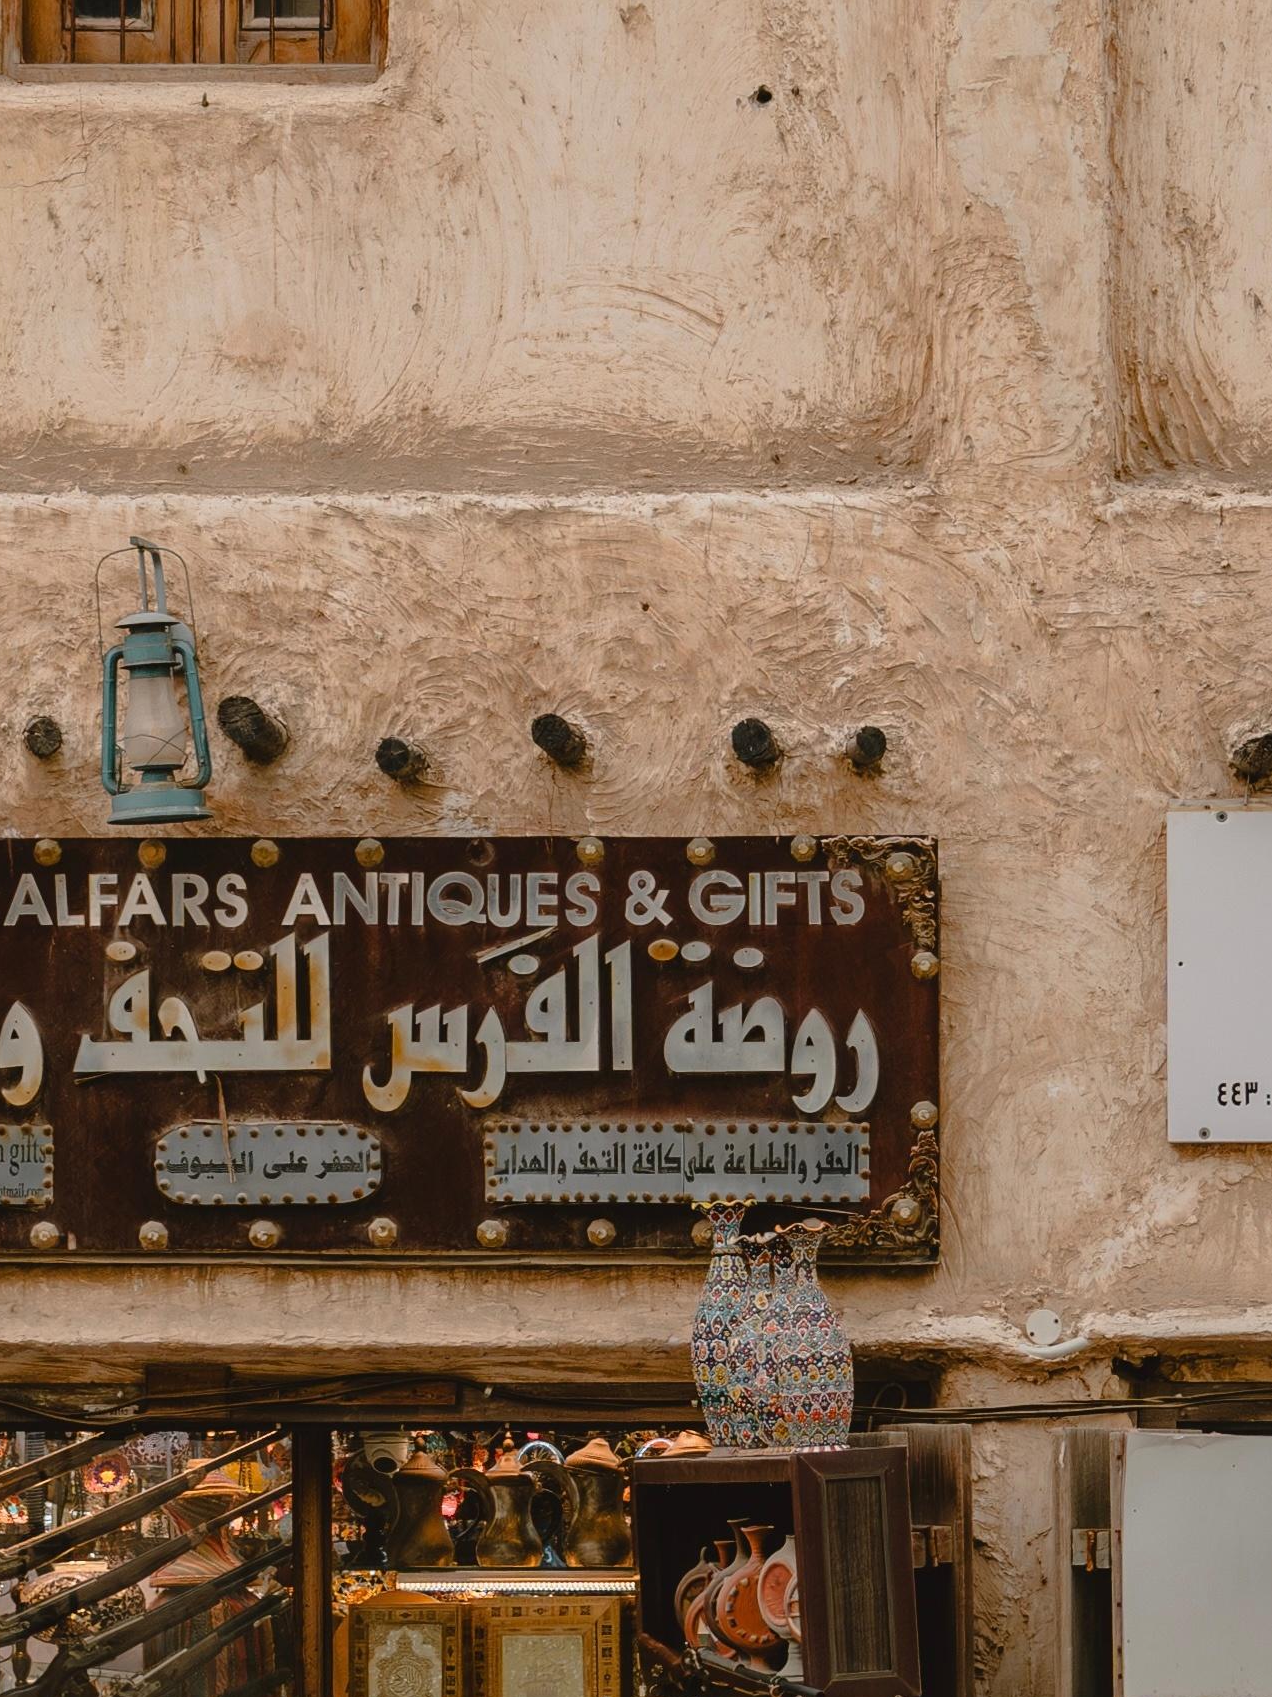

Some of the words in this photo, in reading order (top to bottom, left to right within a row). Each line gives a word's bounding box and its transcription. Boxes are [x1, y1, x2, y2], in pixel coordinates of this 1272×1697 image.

[3, 872, 249, 928] ALFARS
[281, 871, 601, 928] ANTIQUES
[625, 870, 673, 927] &
[688, 870, 866, 927] GIFTS
[72, 931, 332, 1085] للتحف
[647, 938, 880, 1114] روضة
[1216, 1081, 1259, 1107] ٤٤٣
[8, 1132, 47, 1177] gifts
